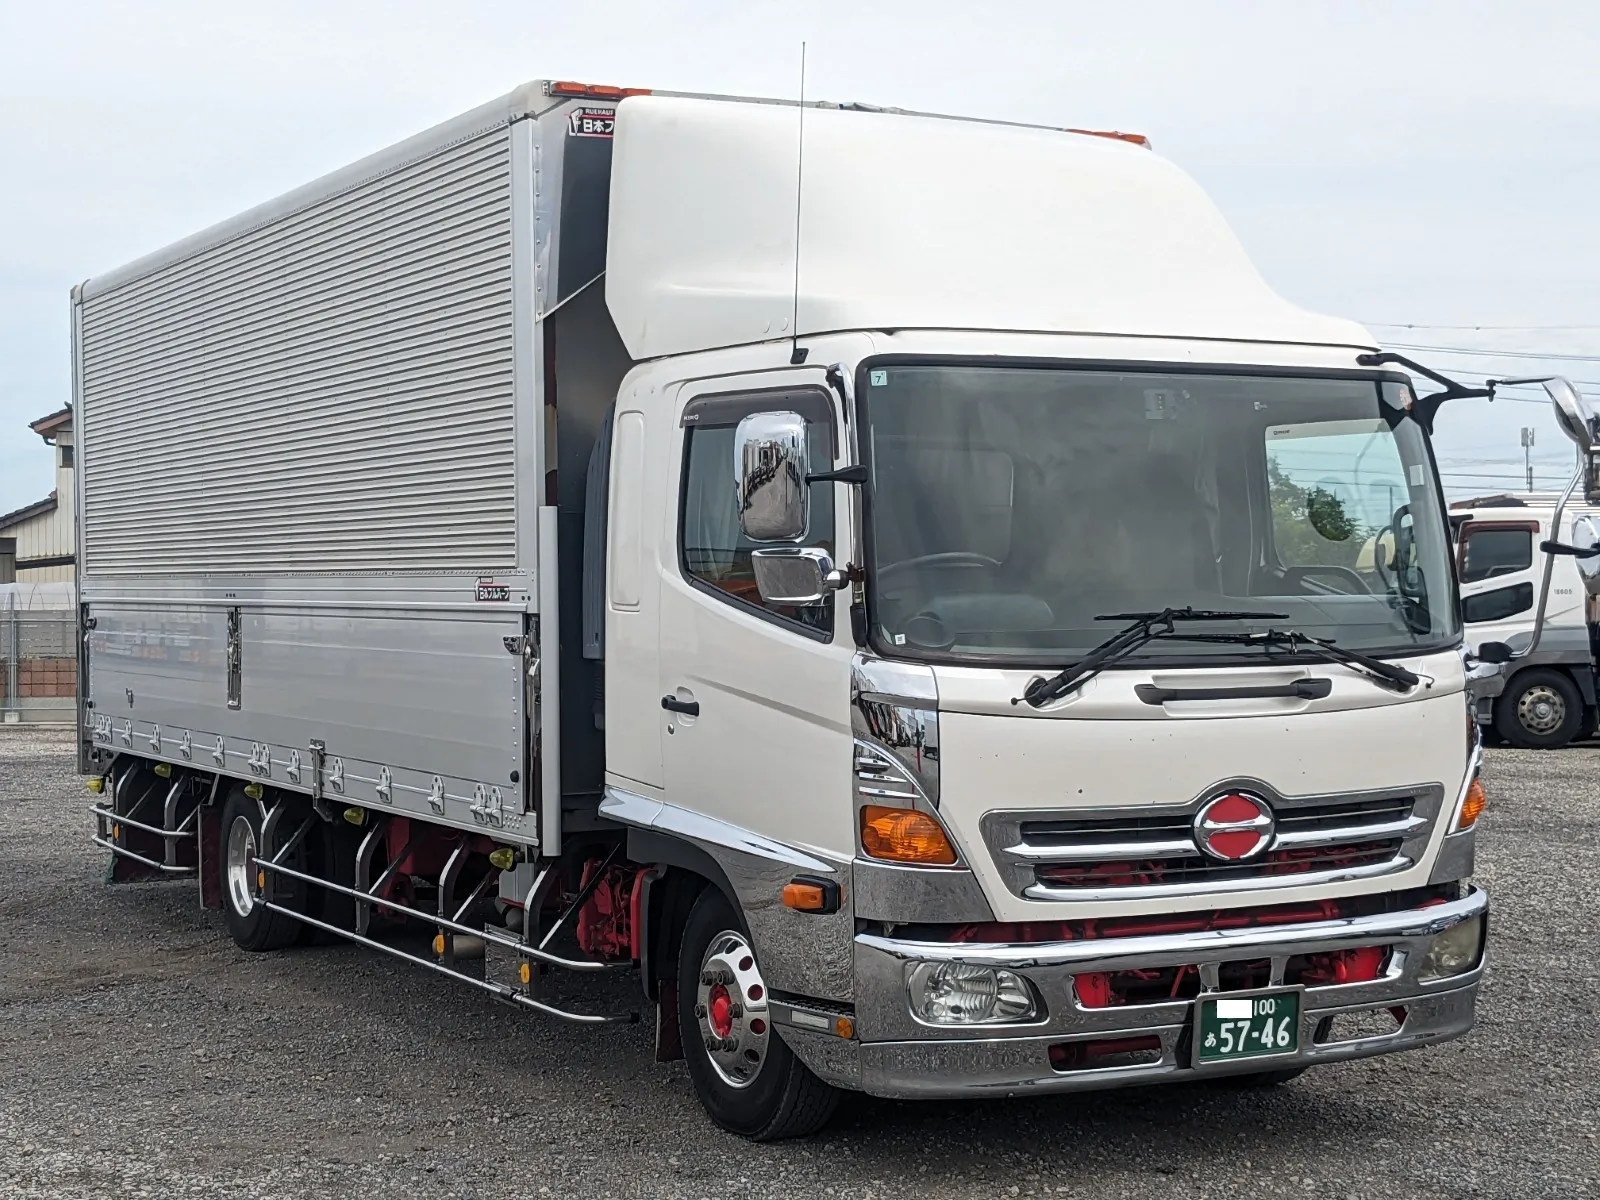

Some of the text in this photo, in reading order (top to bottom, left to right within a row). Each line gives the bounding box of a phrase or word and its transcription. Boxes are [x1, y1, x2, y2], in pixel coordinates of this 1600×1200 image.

[1253, 998, 1275, 1017] 100
[1204, 1016, 1290, 1053] あ 57-46
